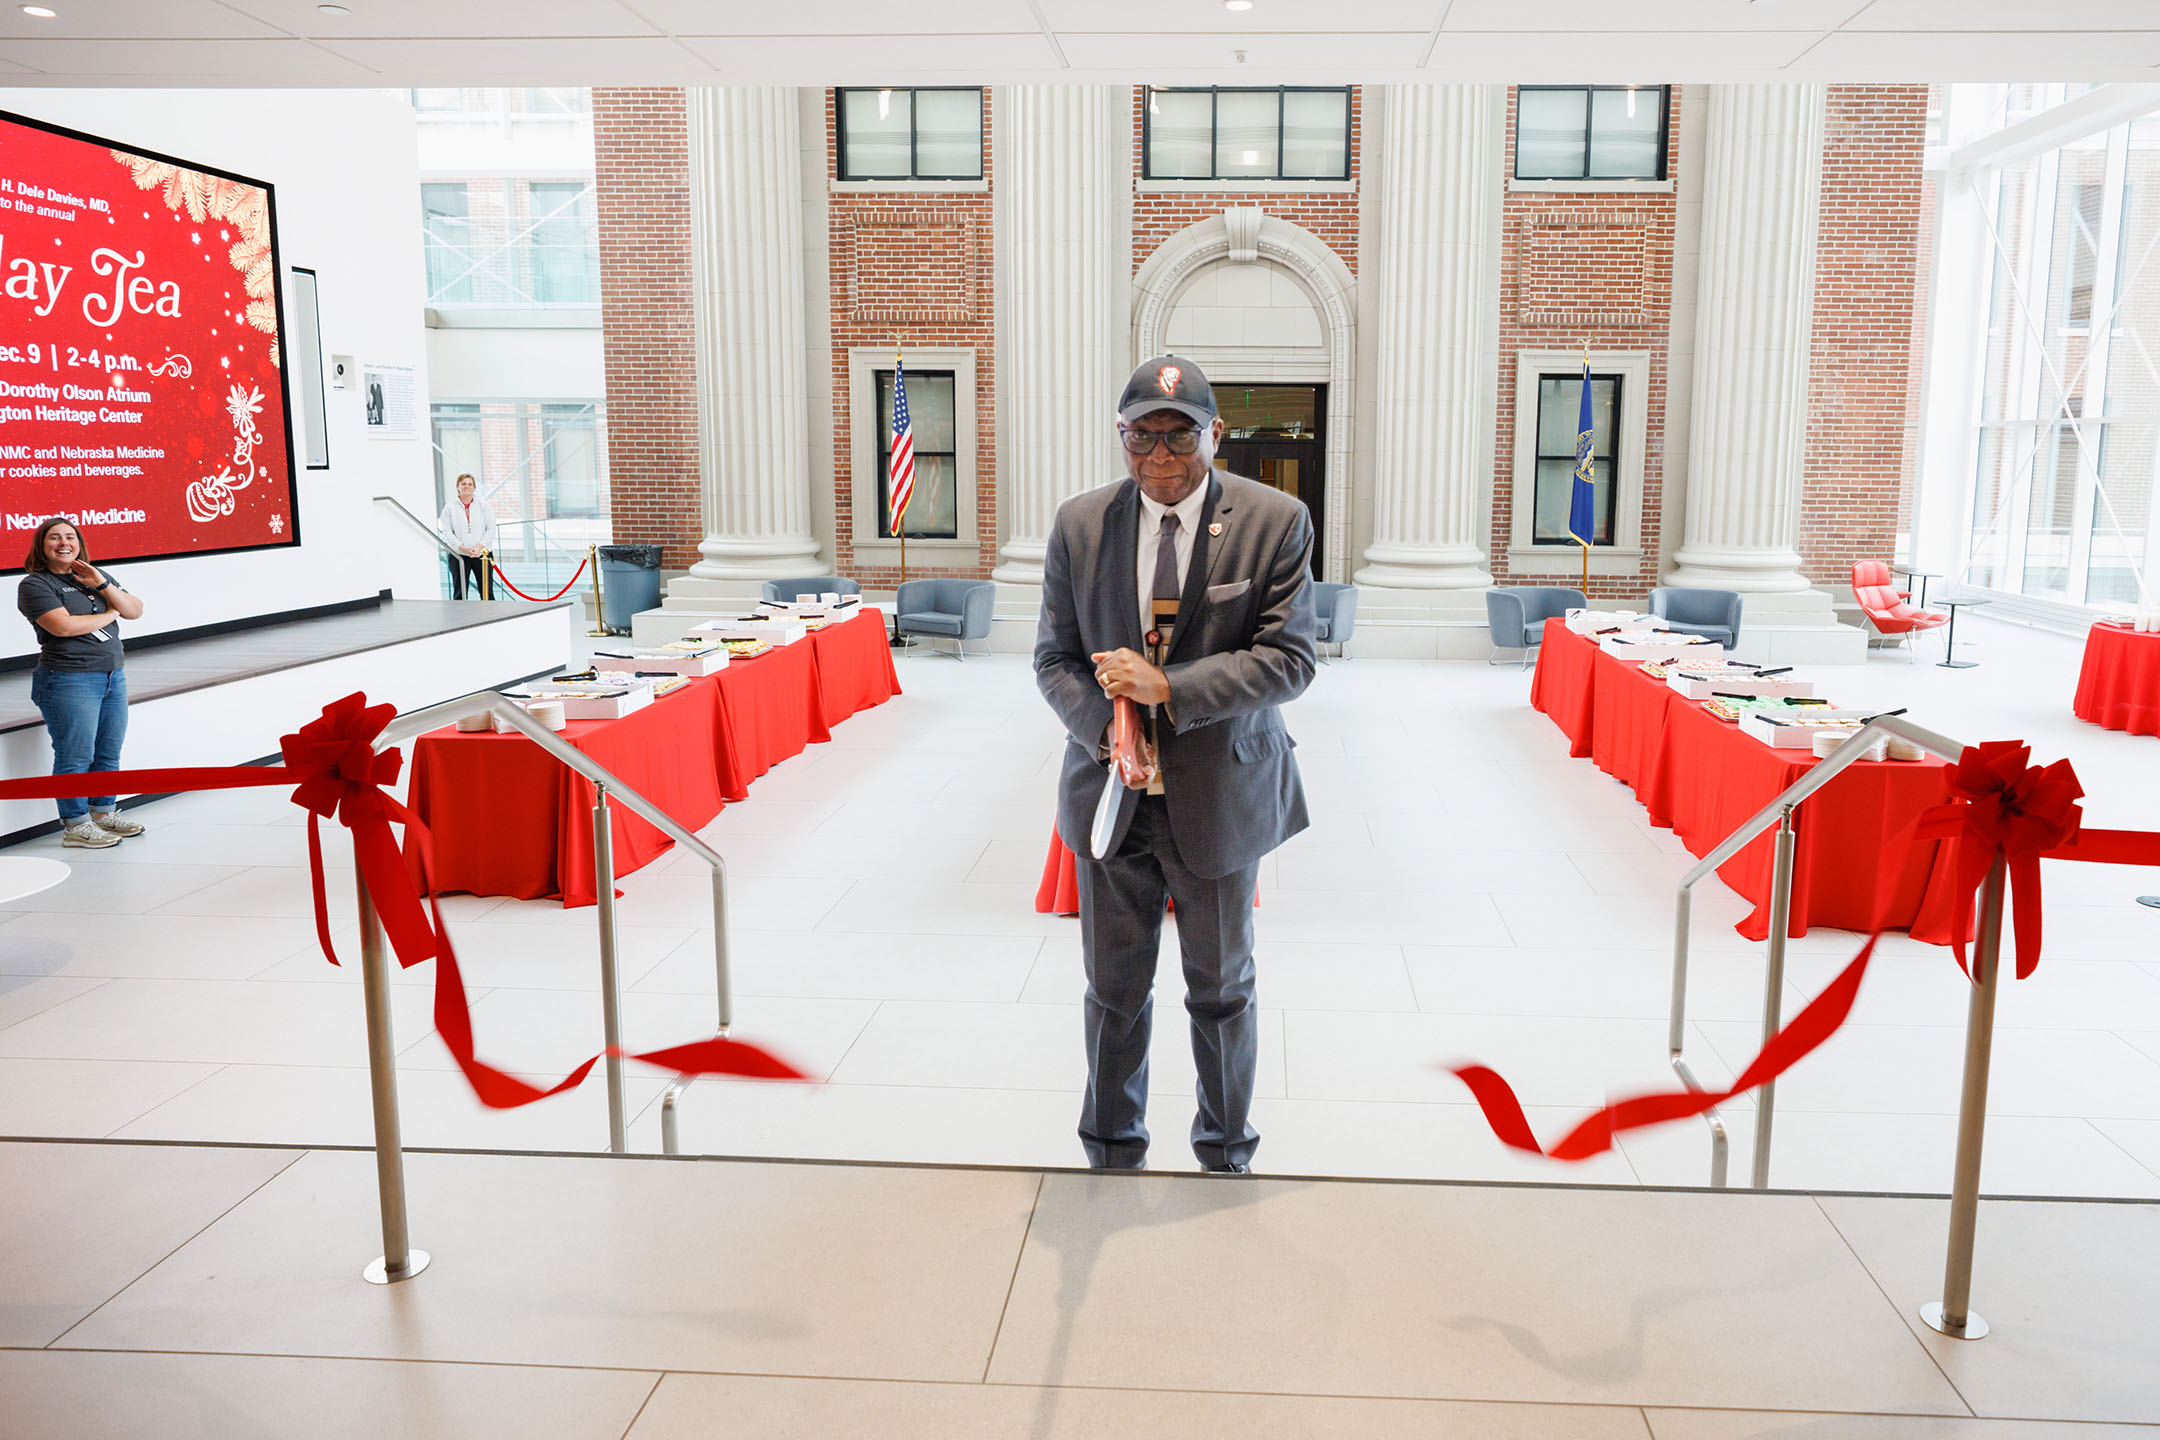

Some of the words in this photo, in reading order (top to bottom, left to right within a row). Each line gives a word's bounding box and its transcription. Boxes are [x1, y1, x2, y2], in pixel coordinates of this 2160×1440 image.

[1, 177, 15, 193] H.
[17, 181, 46, 199] Dele
[46, 187, 88, 210] Davies,
[89, 198, 112, 214] MD,
[0, 196, 13, 209] to
[14, 199, 35, 214] the
[36, 205, 76, 222] annual
[0, 234, 73, 317] ay
[82, 247, 182, 328] Tea
[26, 343, 41, 364] 9
[66, 346, 101, 369] 2-4
[104, 354, 143, 374] p.m.
[0, 380, 60, 403] Dorothy
[62, 383, 104, 401] Olson
[106, 385, 152, 403] Atrium
[34, 404, 97, 426] Heritage
[98, 406, 143, 424] Center
[33, 445, 58, 460] and
[60, 445, 115, 459] Nebraska
[116, 445, 165, 459] Medicine
[8, 463, 58, 478] cookies
[59, 463, 83, 477] and
[84, 463, 145, 479] beverages.
[81, 507, 146, 526] Medicine
